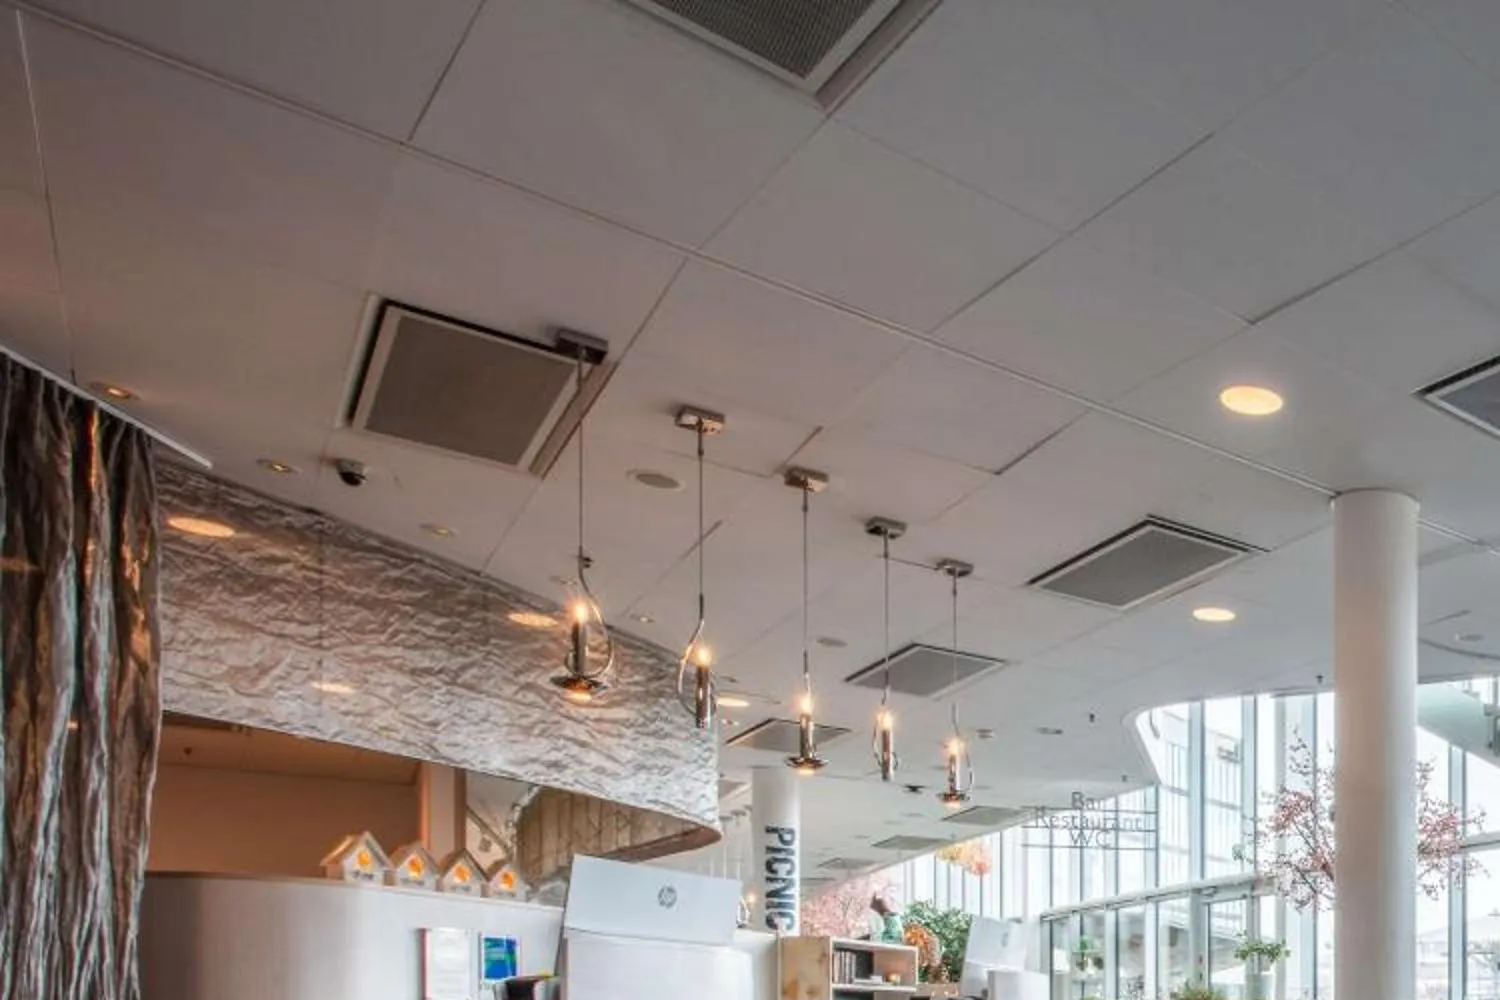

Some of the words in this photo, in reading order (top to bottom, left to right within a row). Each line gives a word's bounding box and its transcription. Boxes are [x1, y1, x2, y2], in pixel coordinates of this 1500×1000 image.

[1071, 791, 1104, 811] Bar
[1034, 805, 1144, 831] Restaurant
[1069, 829, 1111, 848] WC
[765, 825, 796, 931] PICNIC
